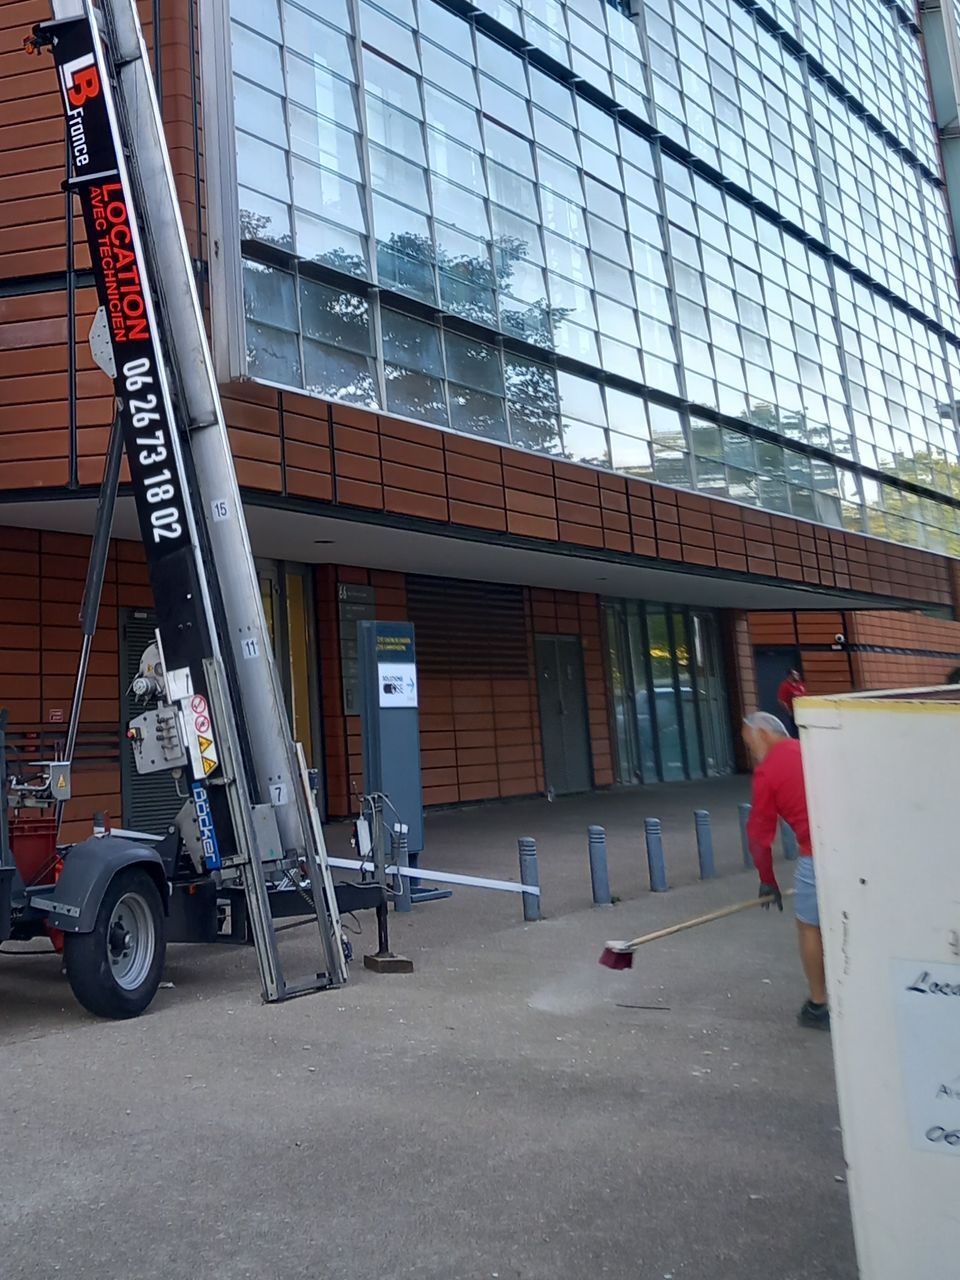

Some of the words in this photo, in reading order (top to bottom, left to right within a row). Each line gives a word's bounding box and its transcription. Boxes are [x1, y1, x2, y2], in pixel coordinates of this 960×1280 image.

[61, 52, 100, 107] LB
[68, 107, 89, 167] France
[89, 186, 107, 230] AVEC
[102, 182, 150, 342] LOCATION
[97, 235, 127, 343] TECHNICIEN
[123, 357, 153, 391] 06
[129, 394, 159, 428] 26
[136, 430, 167, 466] 73
[143, 469, 175, 504] 18
[150, 507, 182, 544] 02
[214, 502, 228, 518] 15
[245, 639, 257, 656] 11
[274, 786, 283, 803] 7
